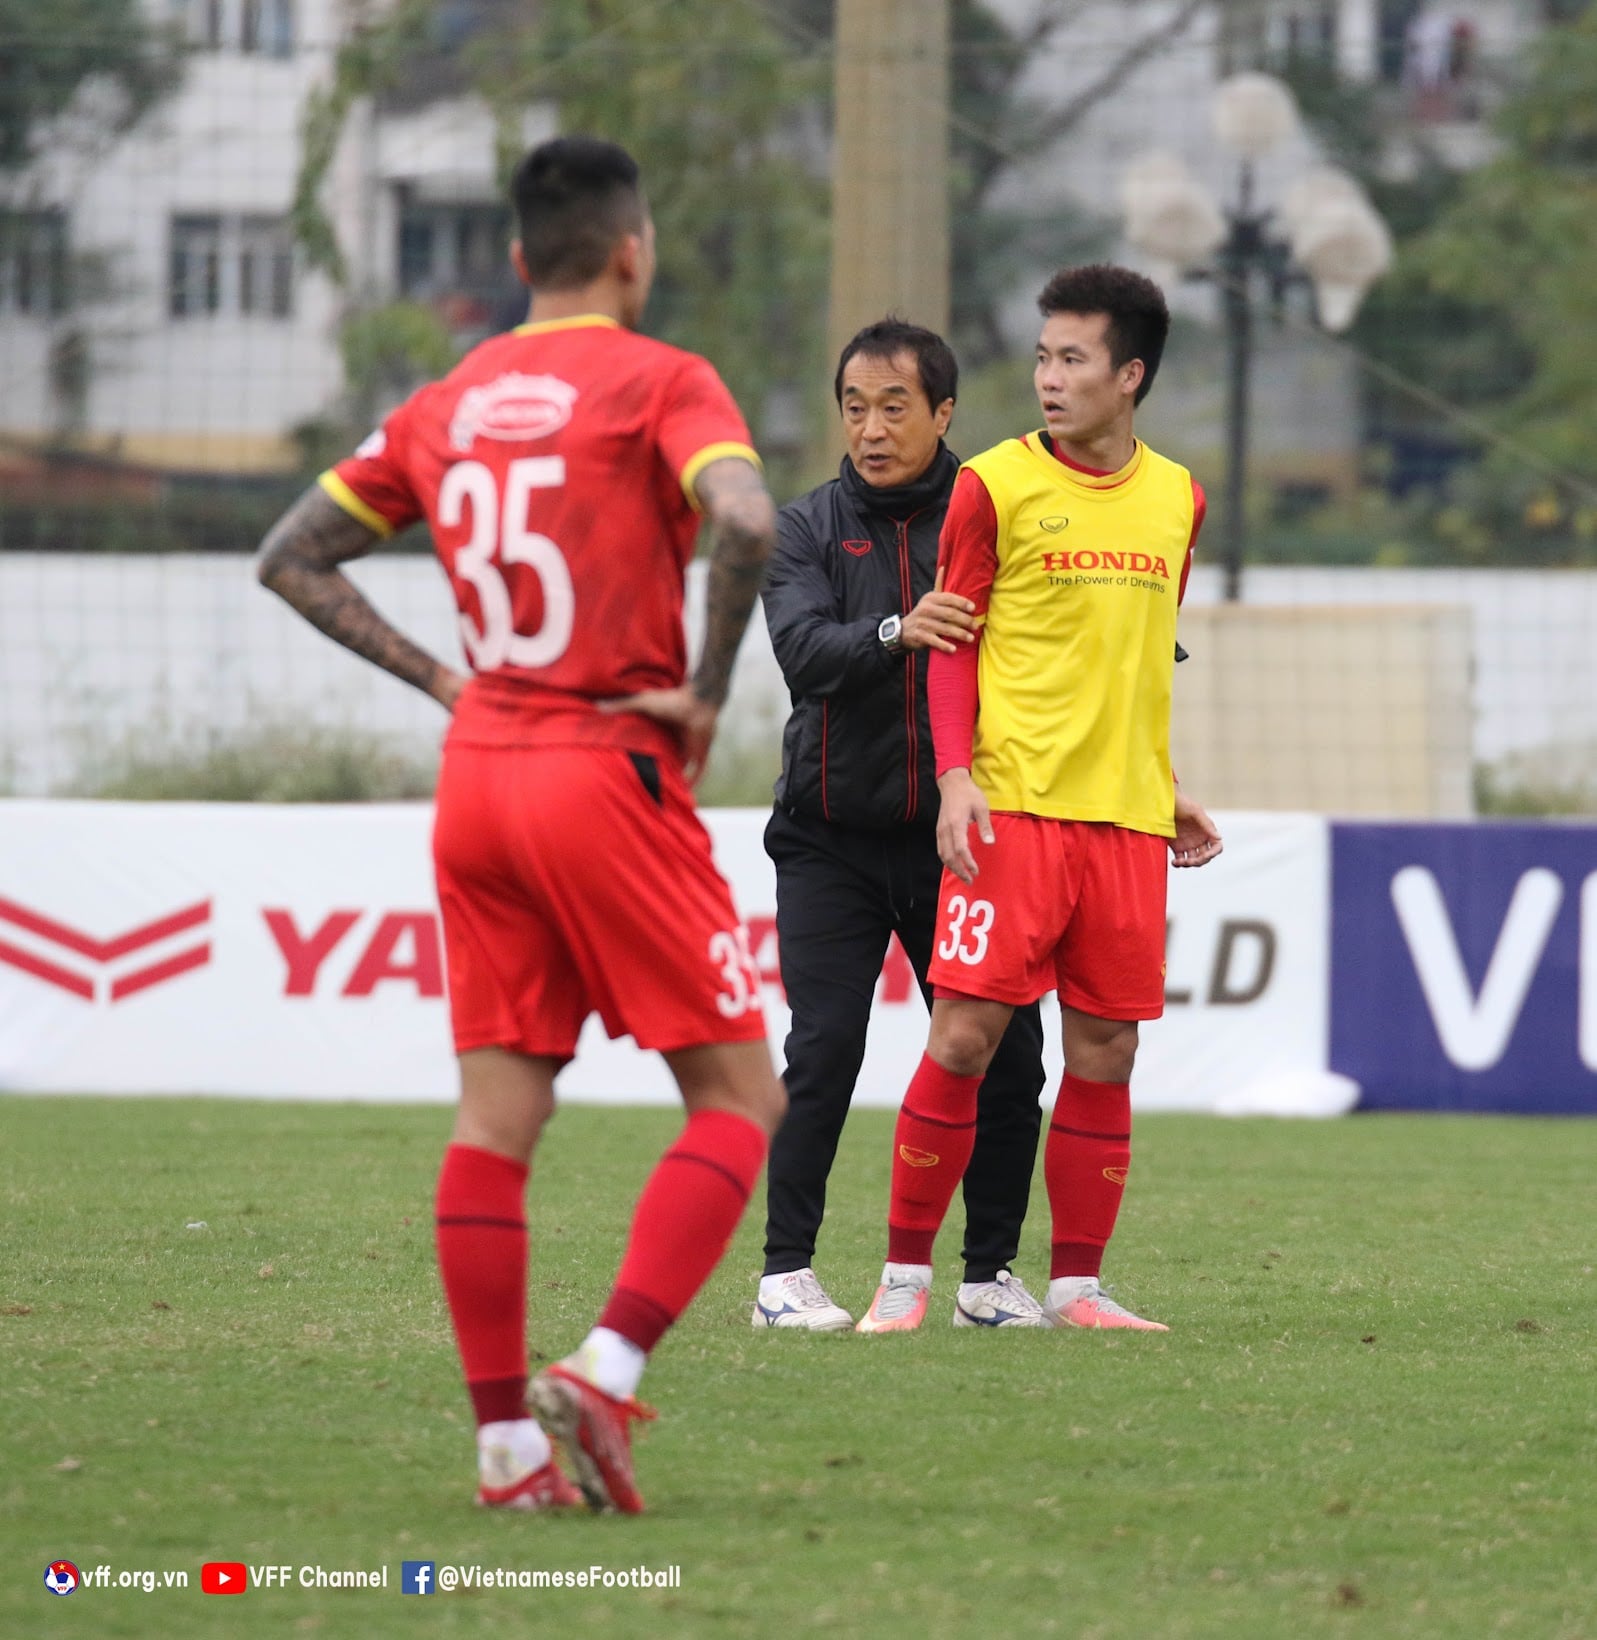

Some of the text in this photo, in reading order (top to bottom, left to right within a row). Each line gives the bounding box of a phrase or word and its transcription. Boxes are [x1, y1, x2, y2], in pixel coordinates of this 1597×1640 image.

[438, 454, 576, 670] 35
[1042, 550, 1170, 580] HONDA
[1048, 576, 1072, 585] The
[1075, 575, 1113, 585] Power
[1116, 577, 1128, 586] of
[938, 894, 995, 966] 33
[1390, 865, 1597, 1074] V
